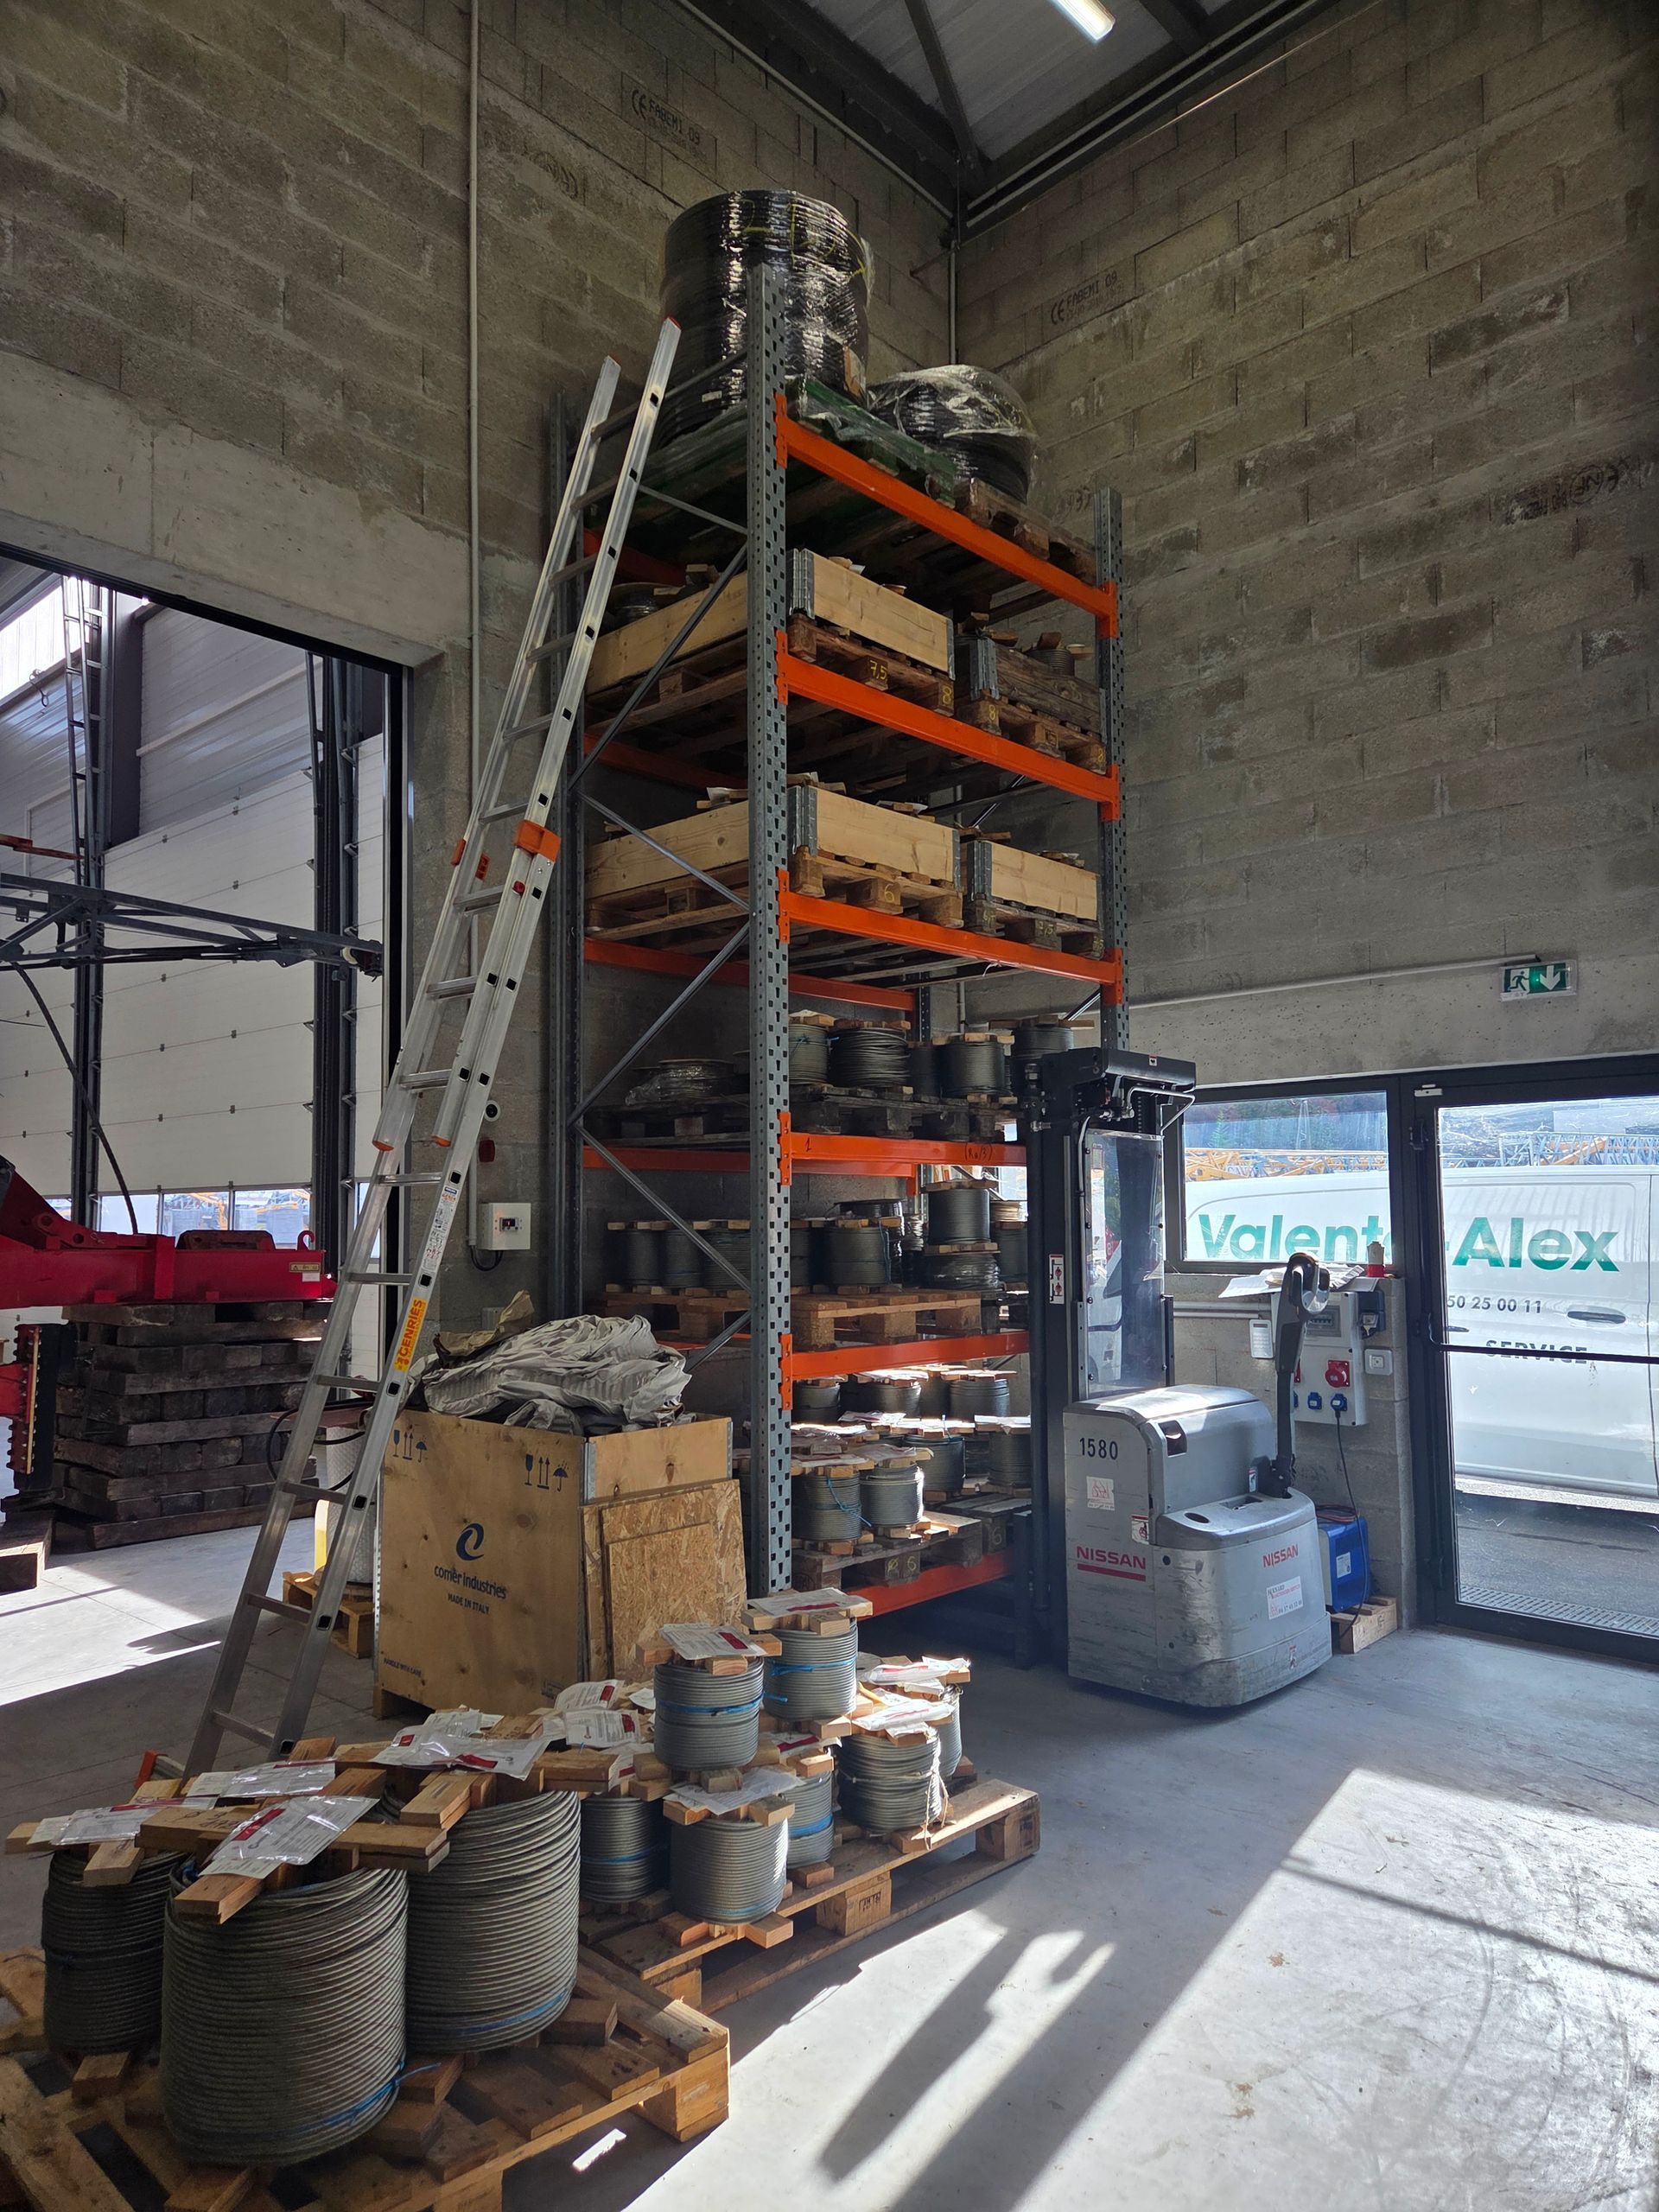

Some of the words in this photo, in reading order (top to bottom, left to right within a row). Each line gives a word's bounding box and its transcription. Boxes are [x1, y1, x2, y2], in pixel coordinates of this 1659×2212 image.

[869, 659, 887, 681] 7,5
[883, 883, 895, 904] 6
[1198, 1214, 1393, 1262] Valent
[1446, 1295, 1466, 1309] 50
[1471, 1296, 1491, 1310] 25
[1497, 1298, 1517, 1313] 00
[1524, 1300, 1542, 1313] 11
[1079, 1437, 1119, 1461] 1580
[1076, 1546, 1147, 1570] NISSAN
[1262, 1544, 1299, 1568] NISSAN
[448, 1593, 464, 1606] MADE
[464, 1599, 472, 1608] IN
[473, 1601, 490, 1615] ITALY
